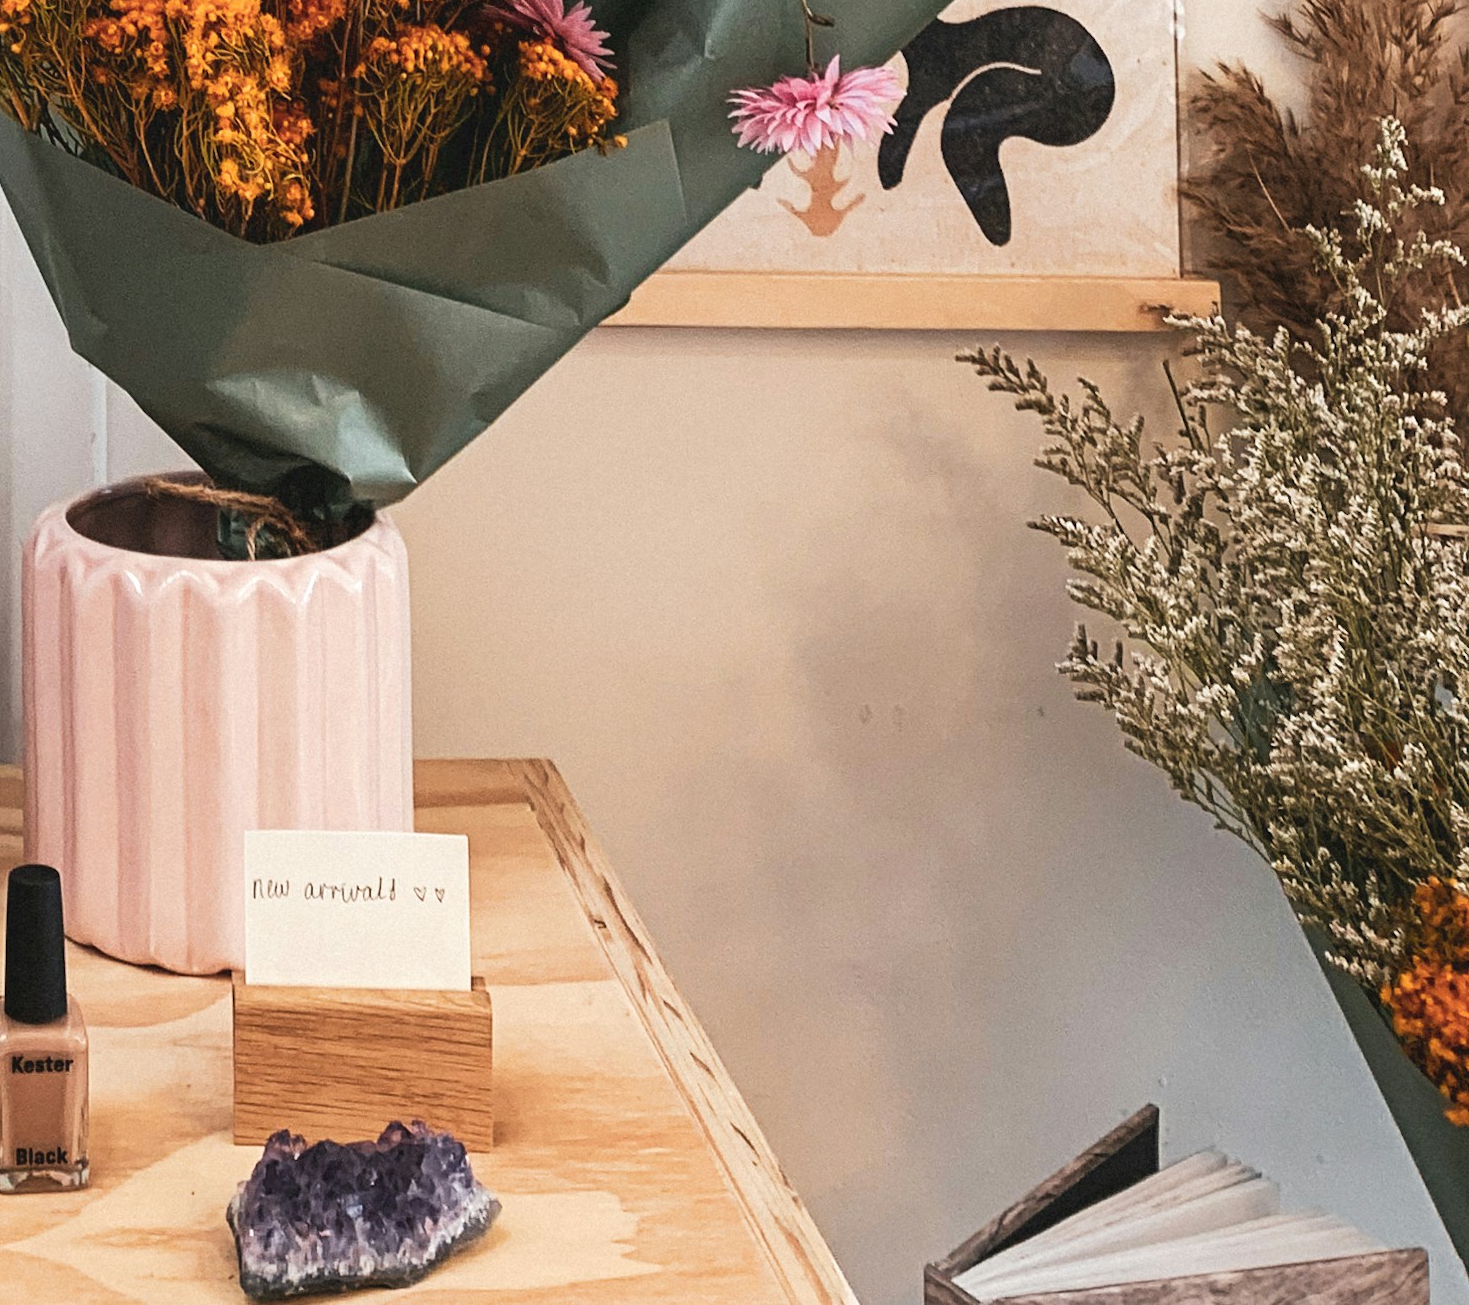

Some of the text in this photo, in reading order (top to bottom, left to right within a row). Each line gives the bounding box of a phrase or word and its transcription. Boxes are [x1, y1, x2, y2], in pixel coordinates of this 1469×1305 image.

[253, 878, 290, 900] new
[11, 1055, 74, 1074] Kester
[16, 1147, 68, 1166] Black
